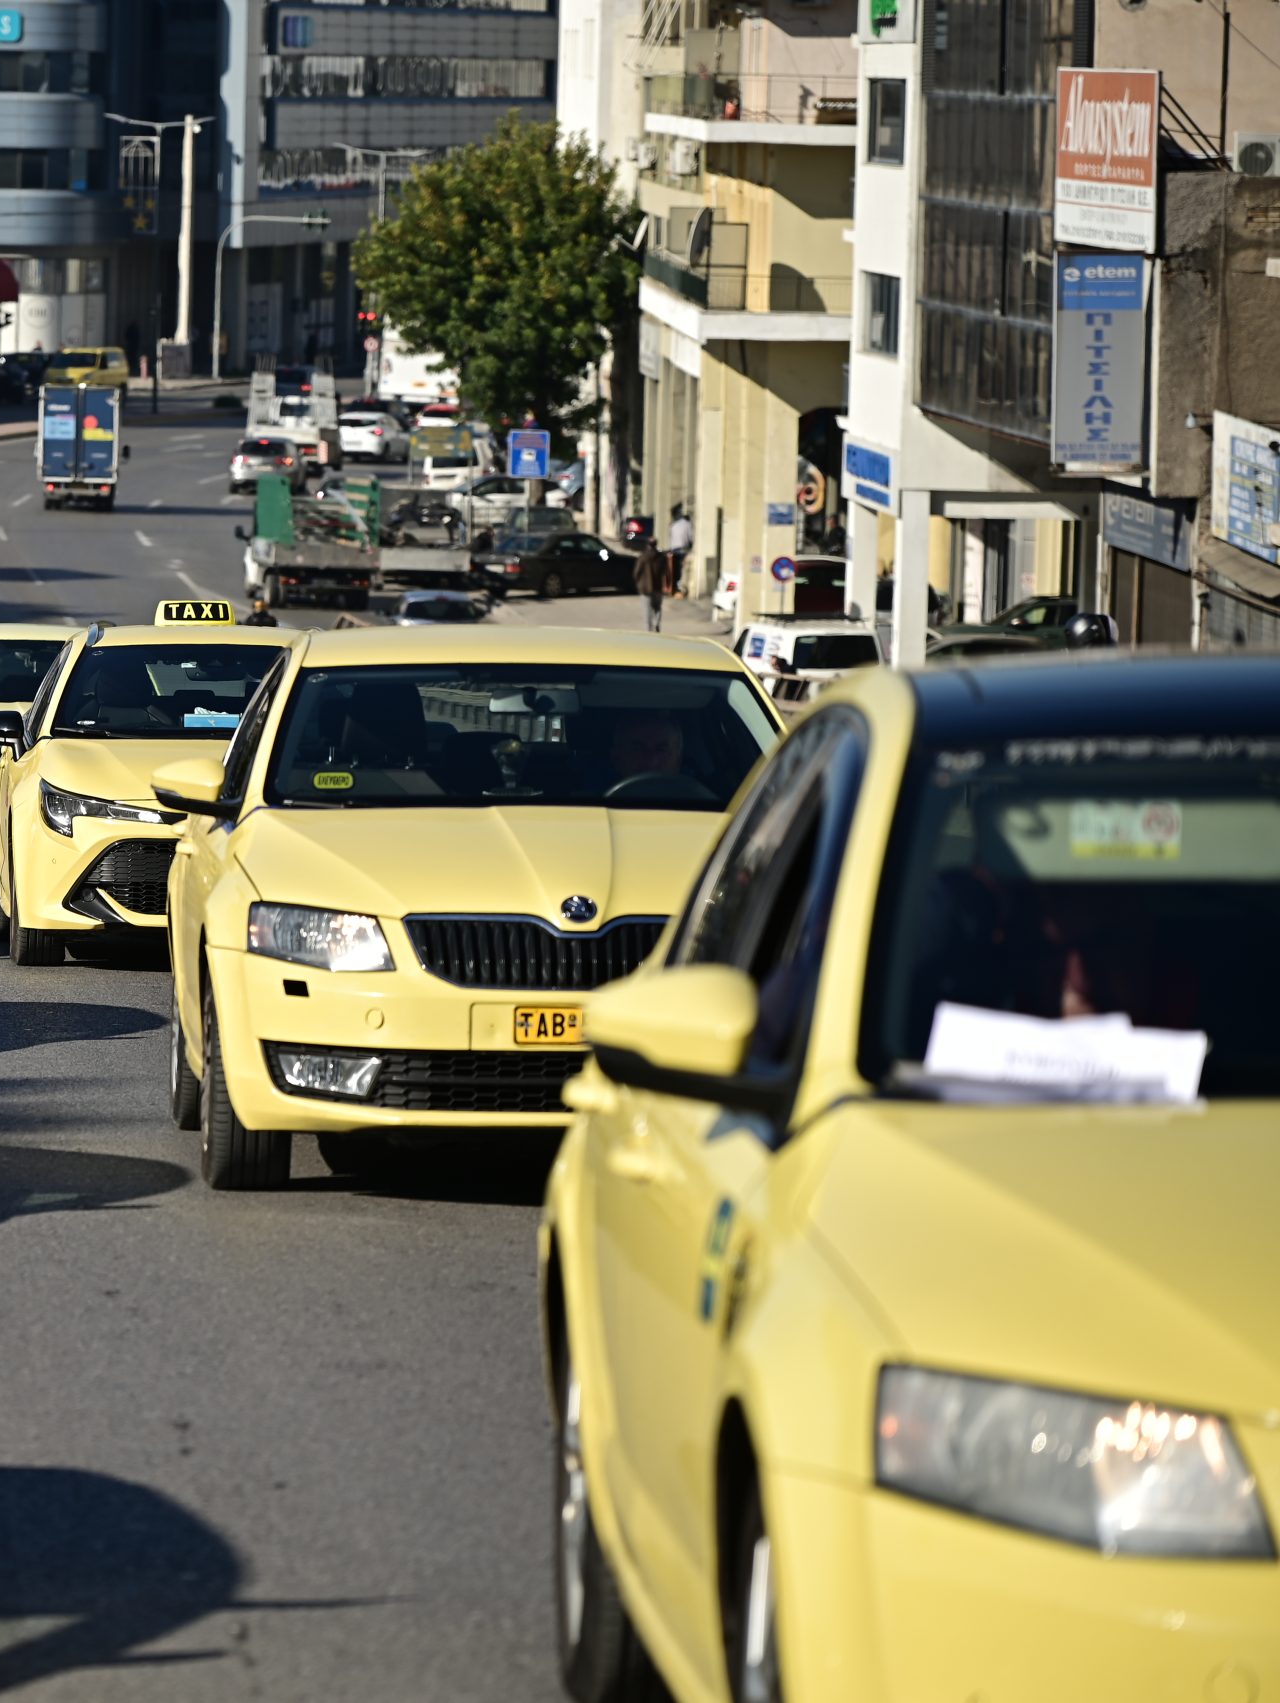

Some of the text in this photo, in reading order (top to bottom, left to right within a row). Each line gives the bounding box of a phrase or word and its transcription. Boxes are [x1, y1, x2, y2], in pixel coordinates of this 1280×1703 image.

[1084, 264, 1137, 279] etem
[1083, 313, 1113, 442] ΠΙΤΣΙΛΗΣ
[168, 604, 224, 618] TAXI
